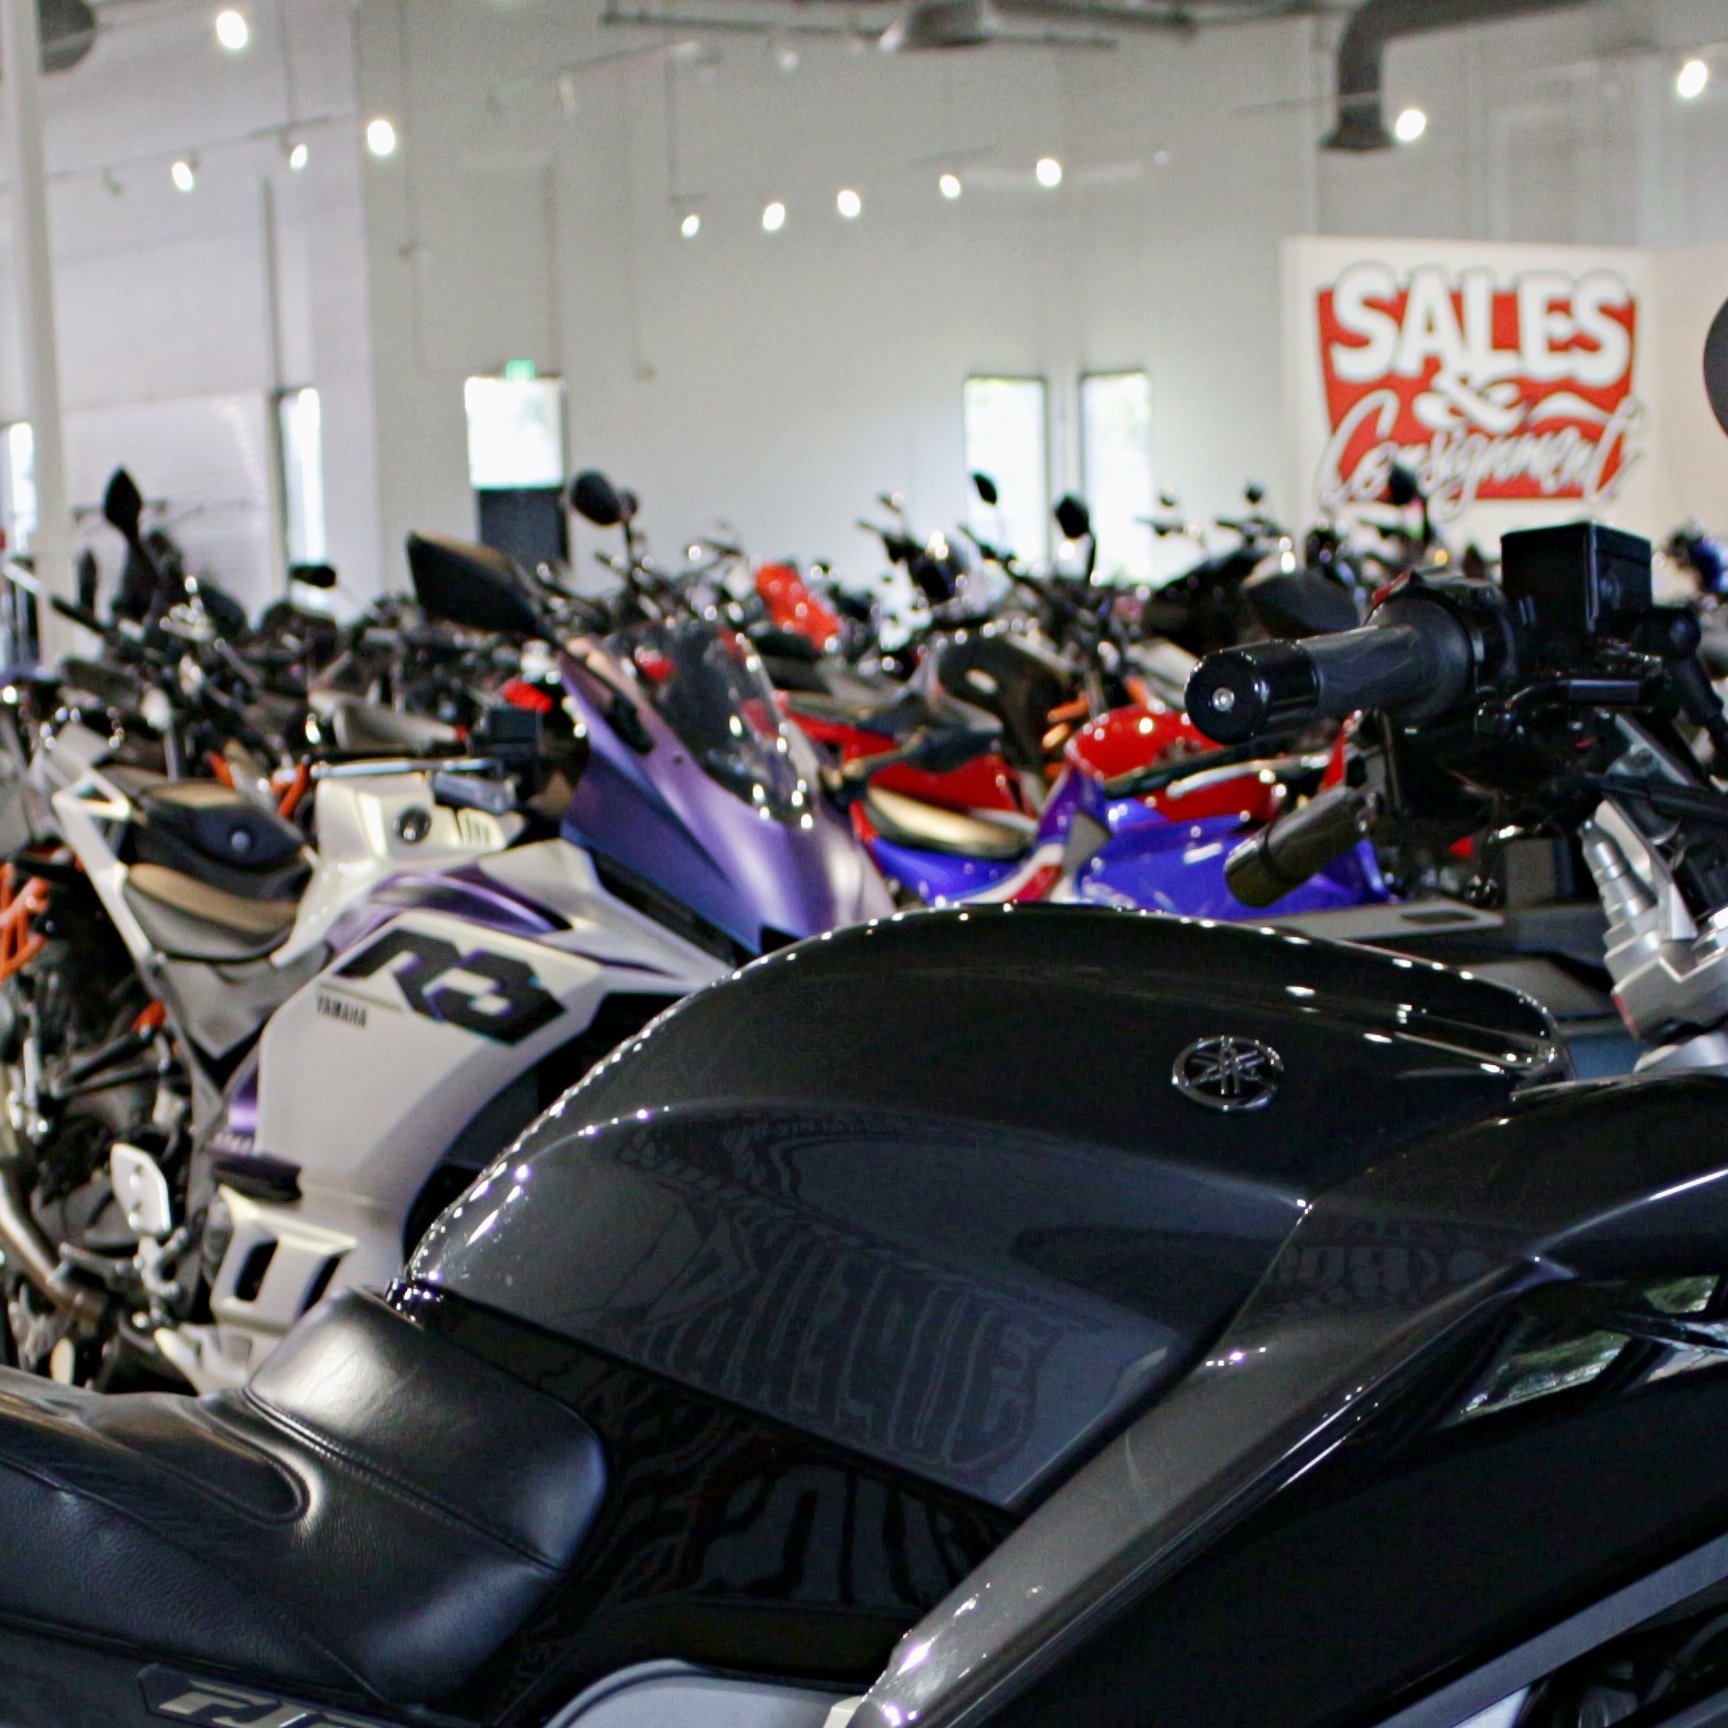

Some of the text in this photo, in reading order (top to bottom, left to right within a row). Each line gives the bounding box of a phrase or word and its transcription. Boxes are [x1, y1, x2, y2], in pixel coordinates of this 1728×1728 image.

[1330, 261, 1633, 387] SALES
[316, 994, 366, 1028] YAMAHA
[334, 928, 565, 1046] R3
